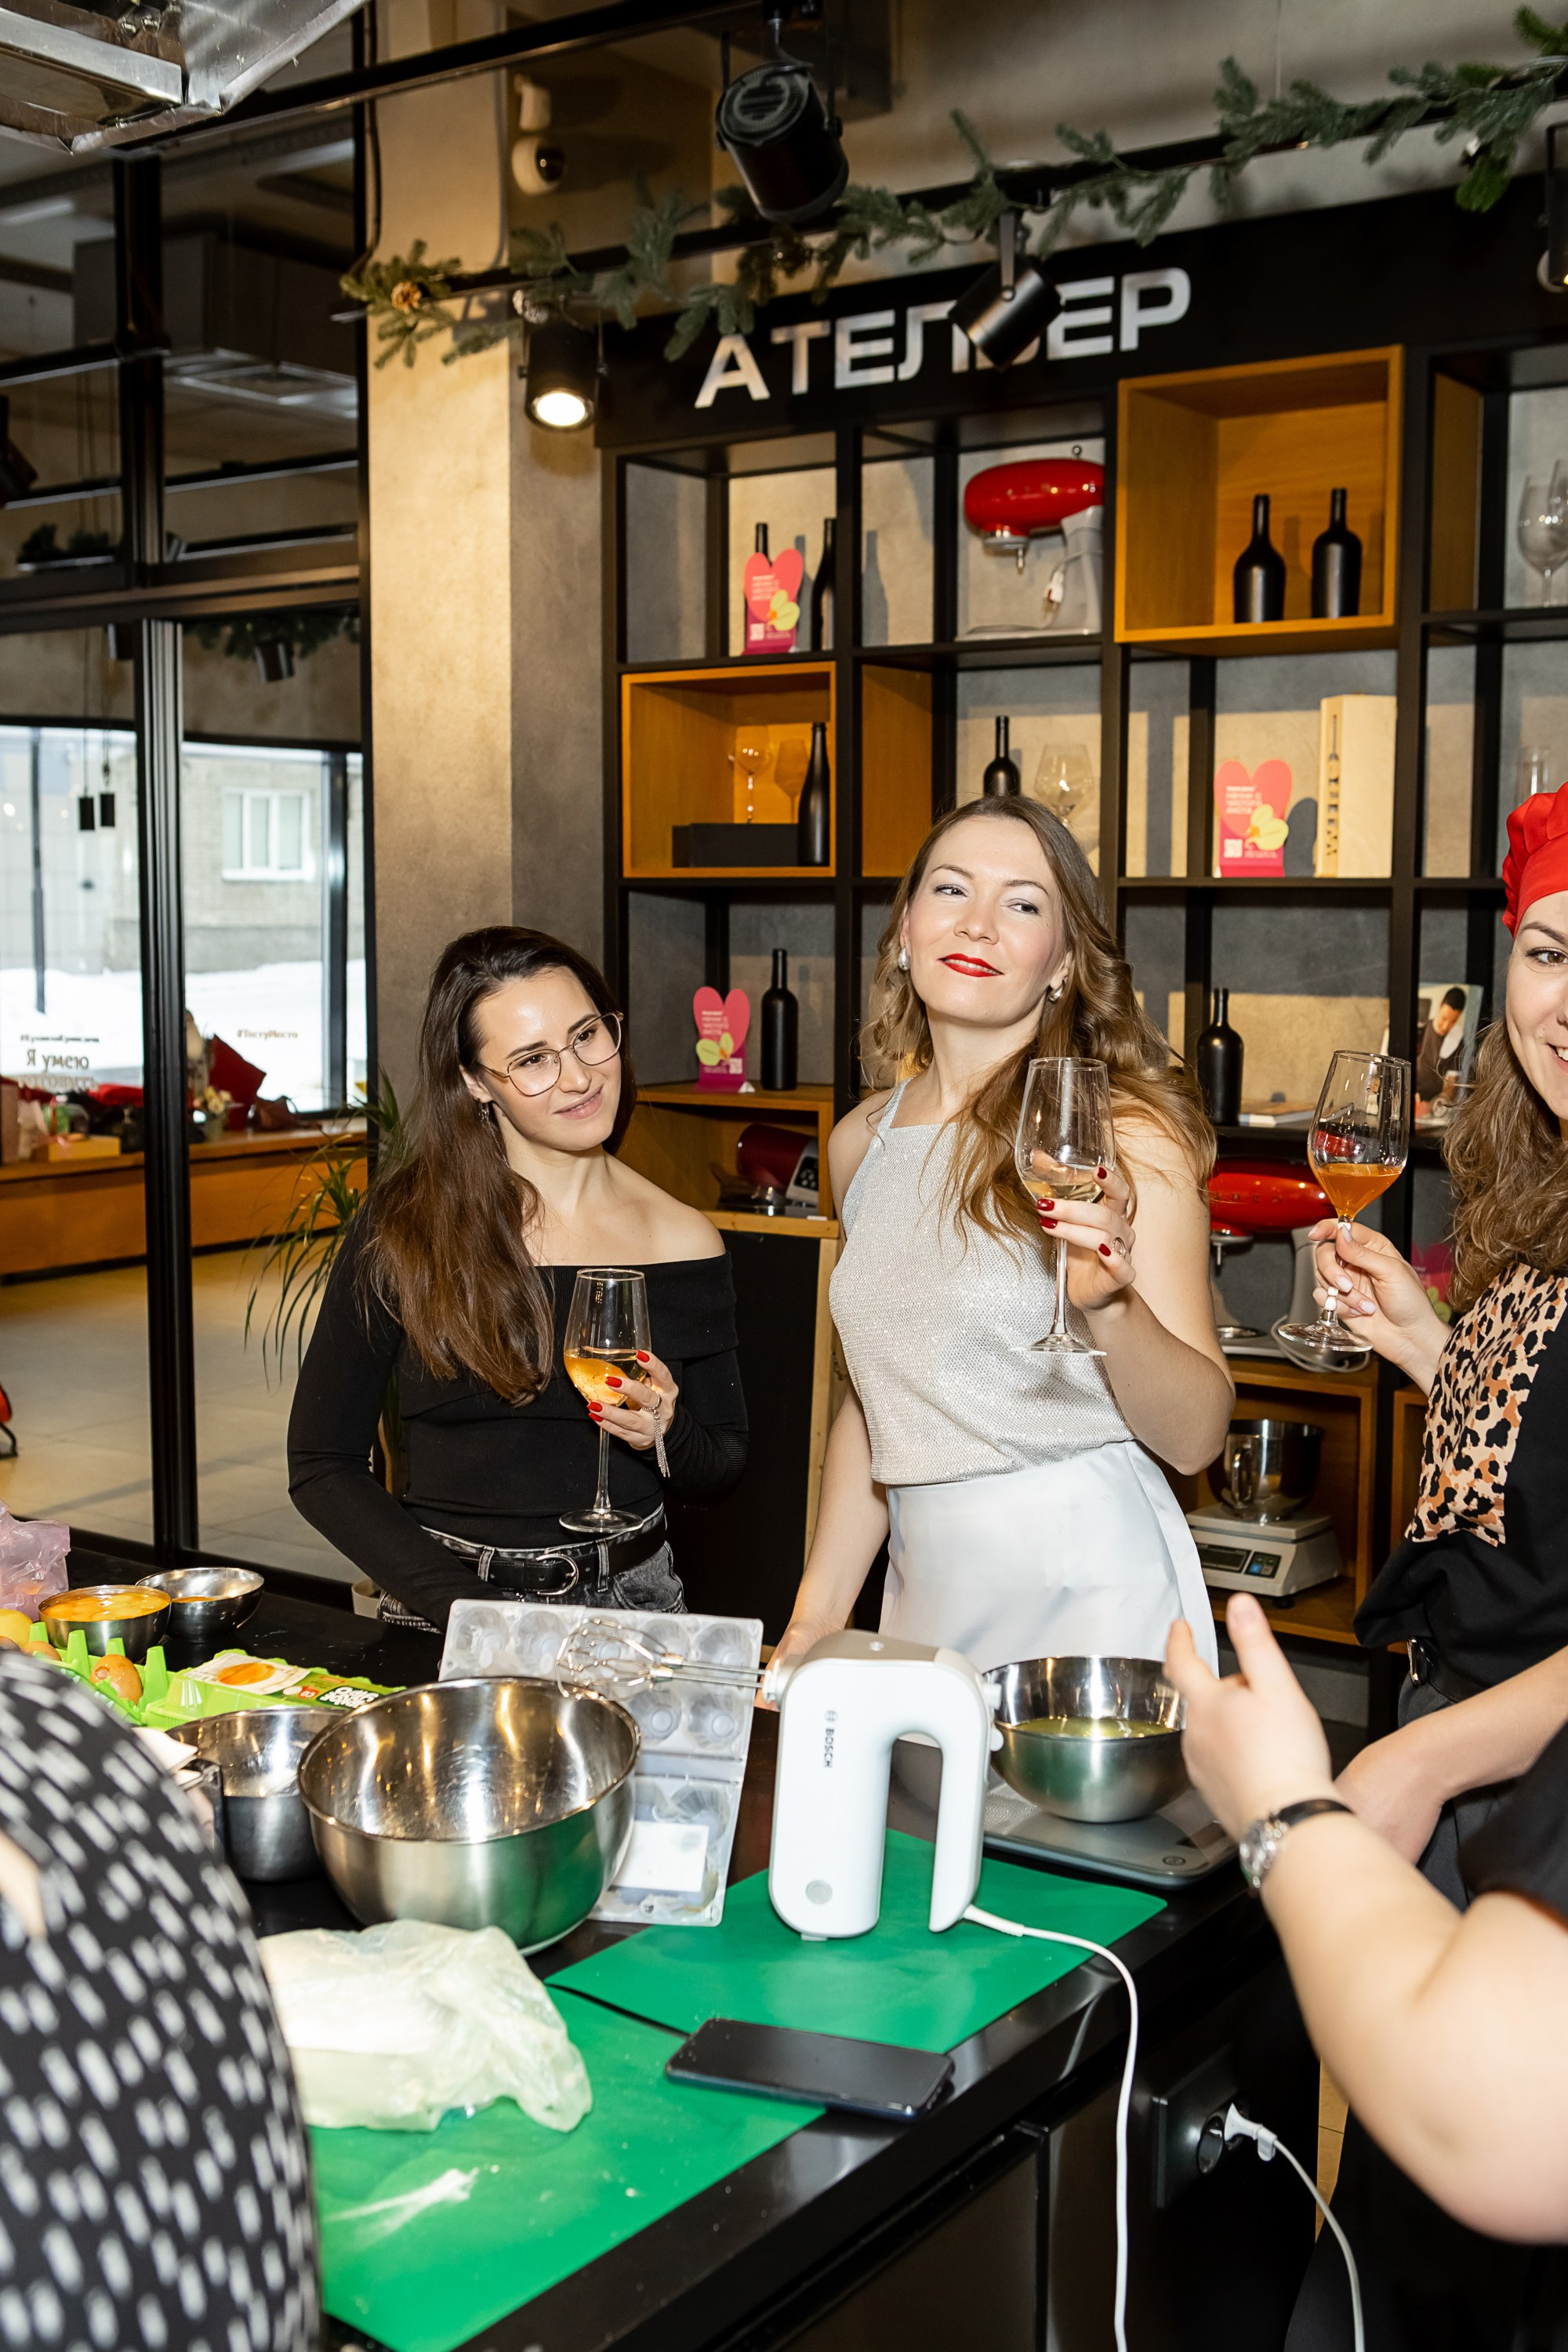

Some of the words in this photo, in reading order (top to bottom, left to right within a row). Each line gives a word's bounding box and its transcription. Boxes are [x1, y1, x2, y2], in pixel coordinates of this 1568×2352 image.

[27, 1049, 36, 1066] Я
[42, 1054, 89, 1073] умею
[824, 1728, 835, 1769] BOSCH
